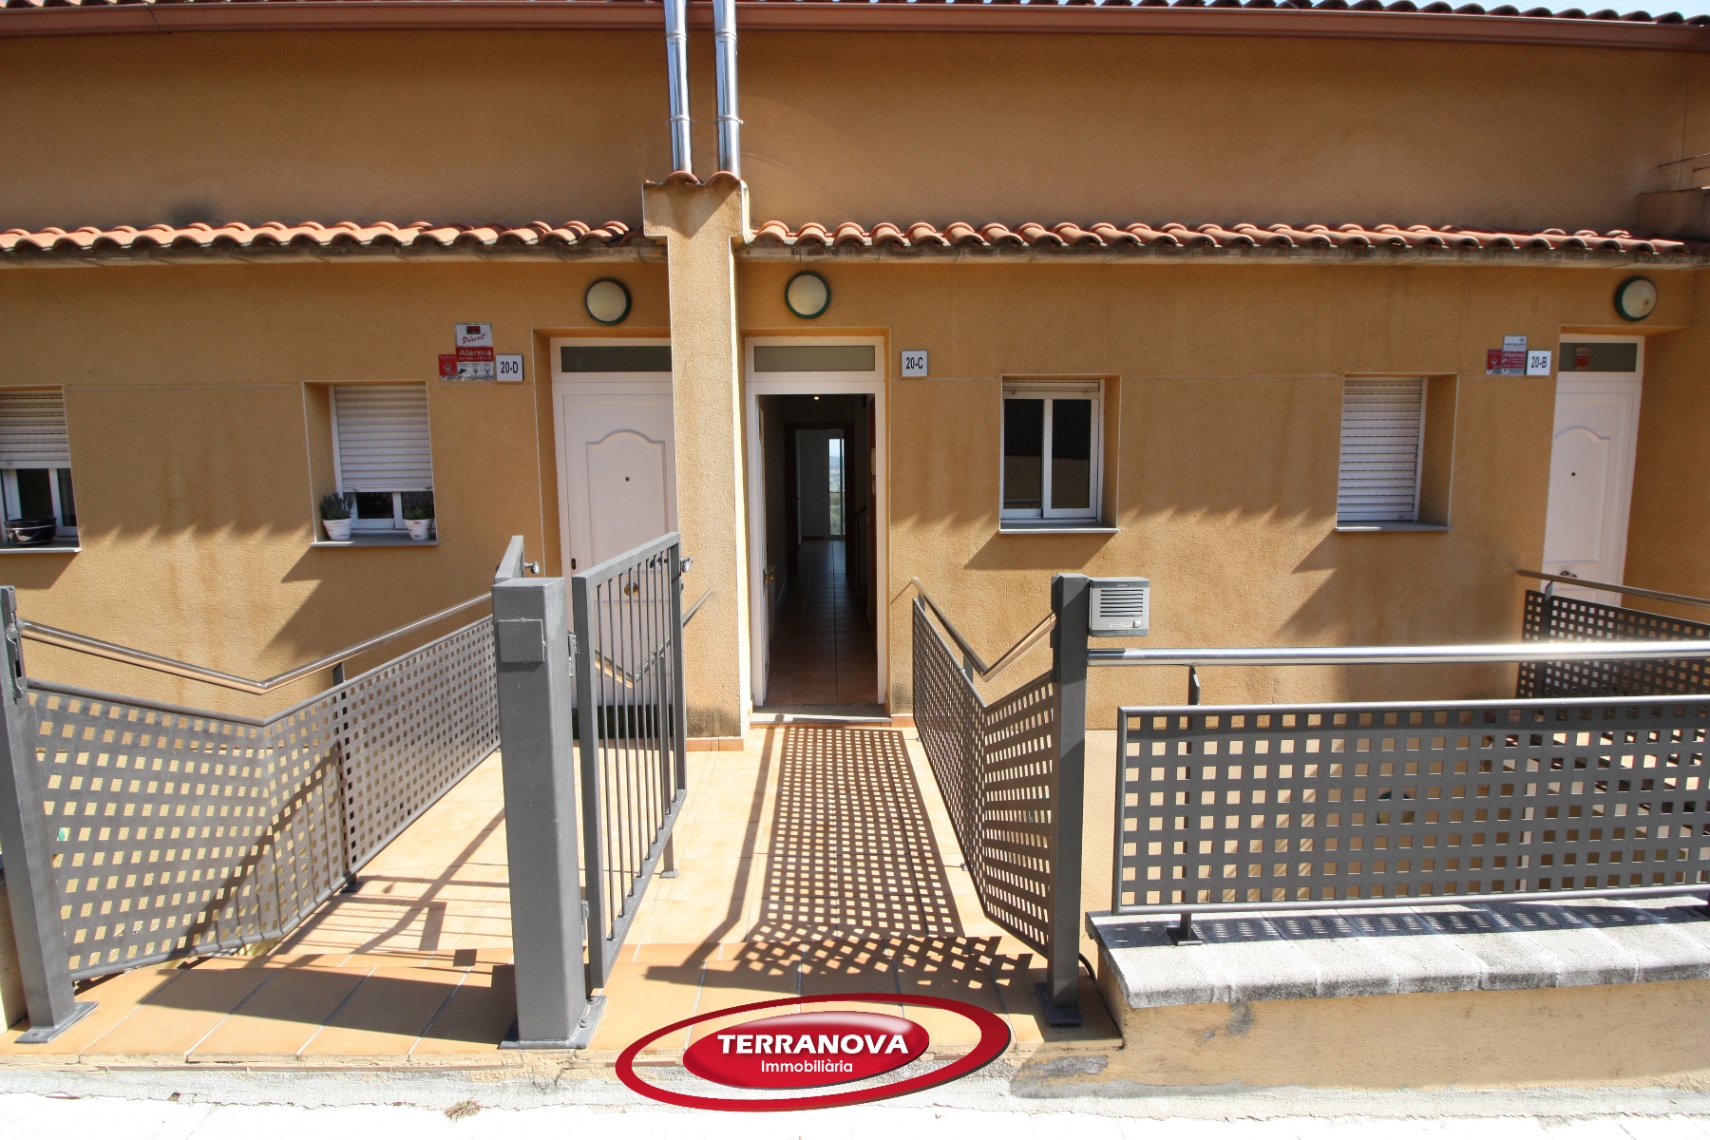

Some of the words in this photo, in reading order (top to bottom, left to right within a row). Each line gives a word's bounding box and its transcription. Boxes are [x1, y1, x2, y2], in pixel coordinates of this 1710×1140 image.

[500, 361, 519, 374] 20-D
[905, 356, 924, 370] 20-C
[1530, 356, 1548, 369] 20-B
